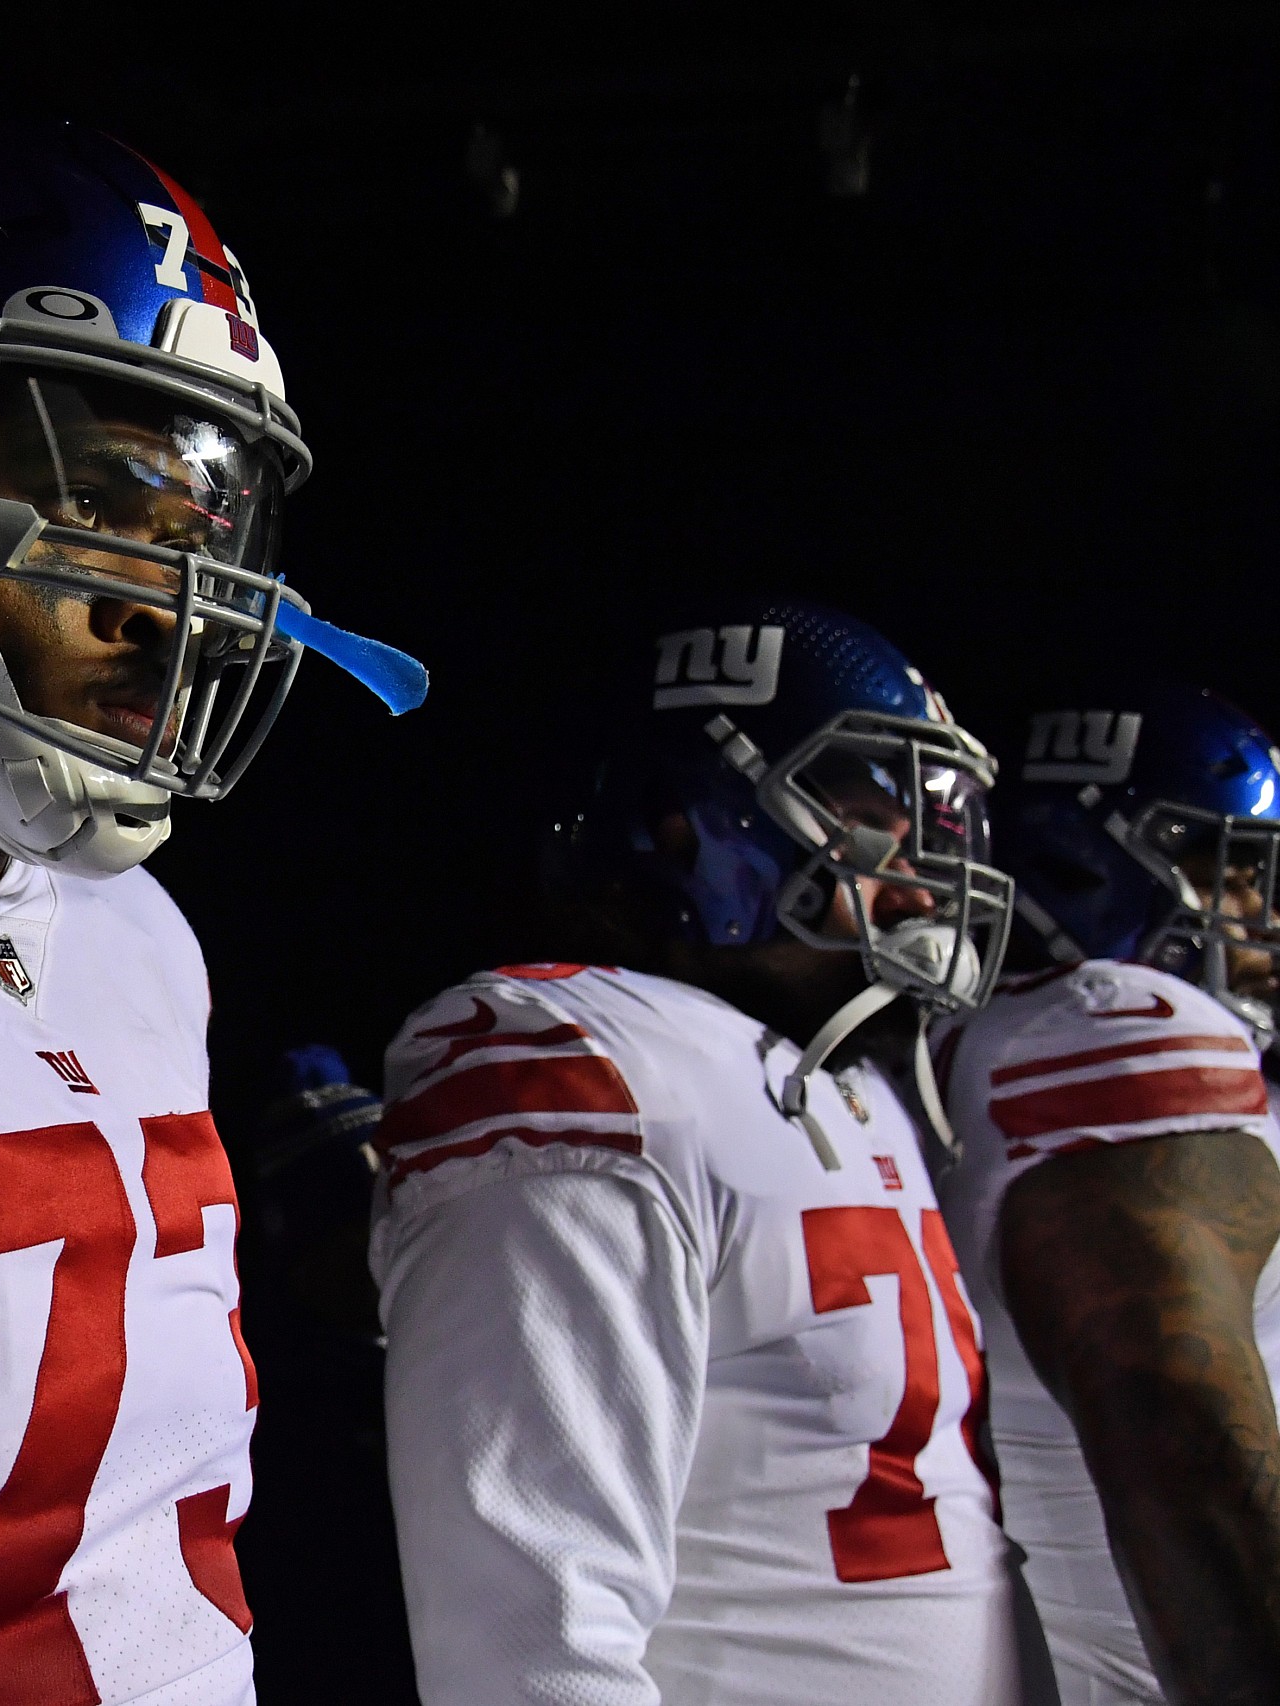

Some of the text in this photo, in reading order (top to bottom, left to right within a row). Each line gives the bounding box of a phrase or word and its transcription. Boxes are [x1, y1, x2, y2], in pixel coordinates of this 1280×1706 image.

[653, 624, 786, 711] ny
[1023, 709, 1144, 786] ny
[35, 1050, 101, 1096] ny
